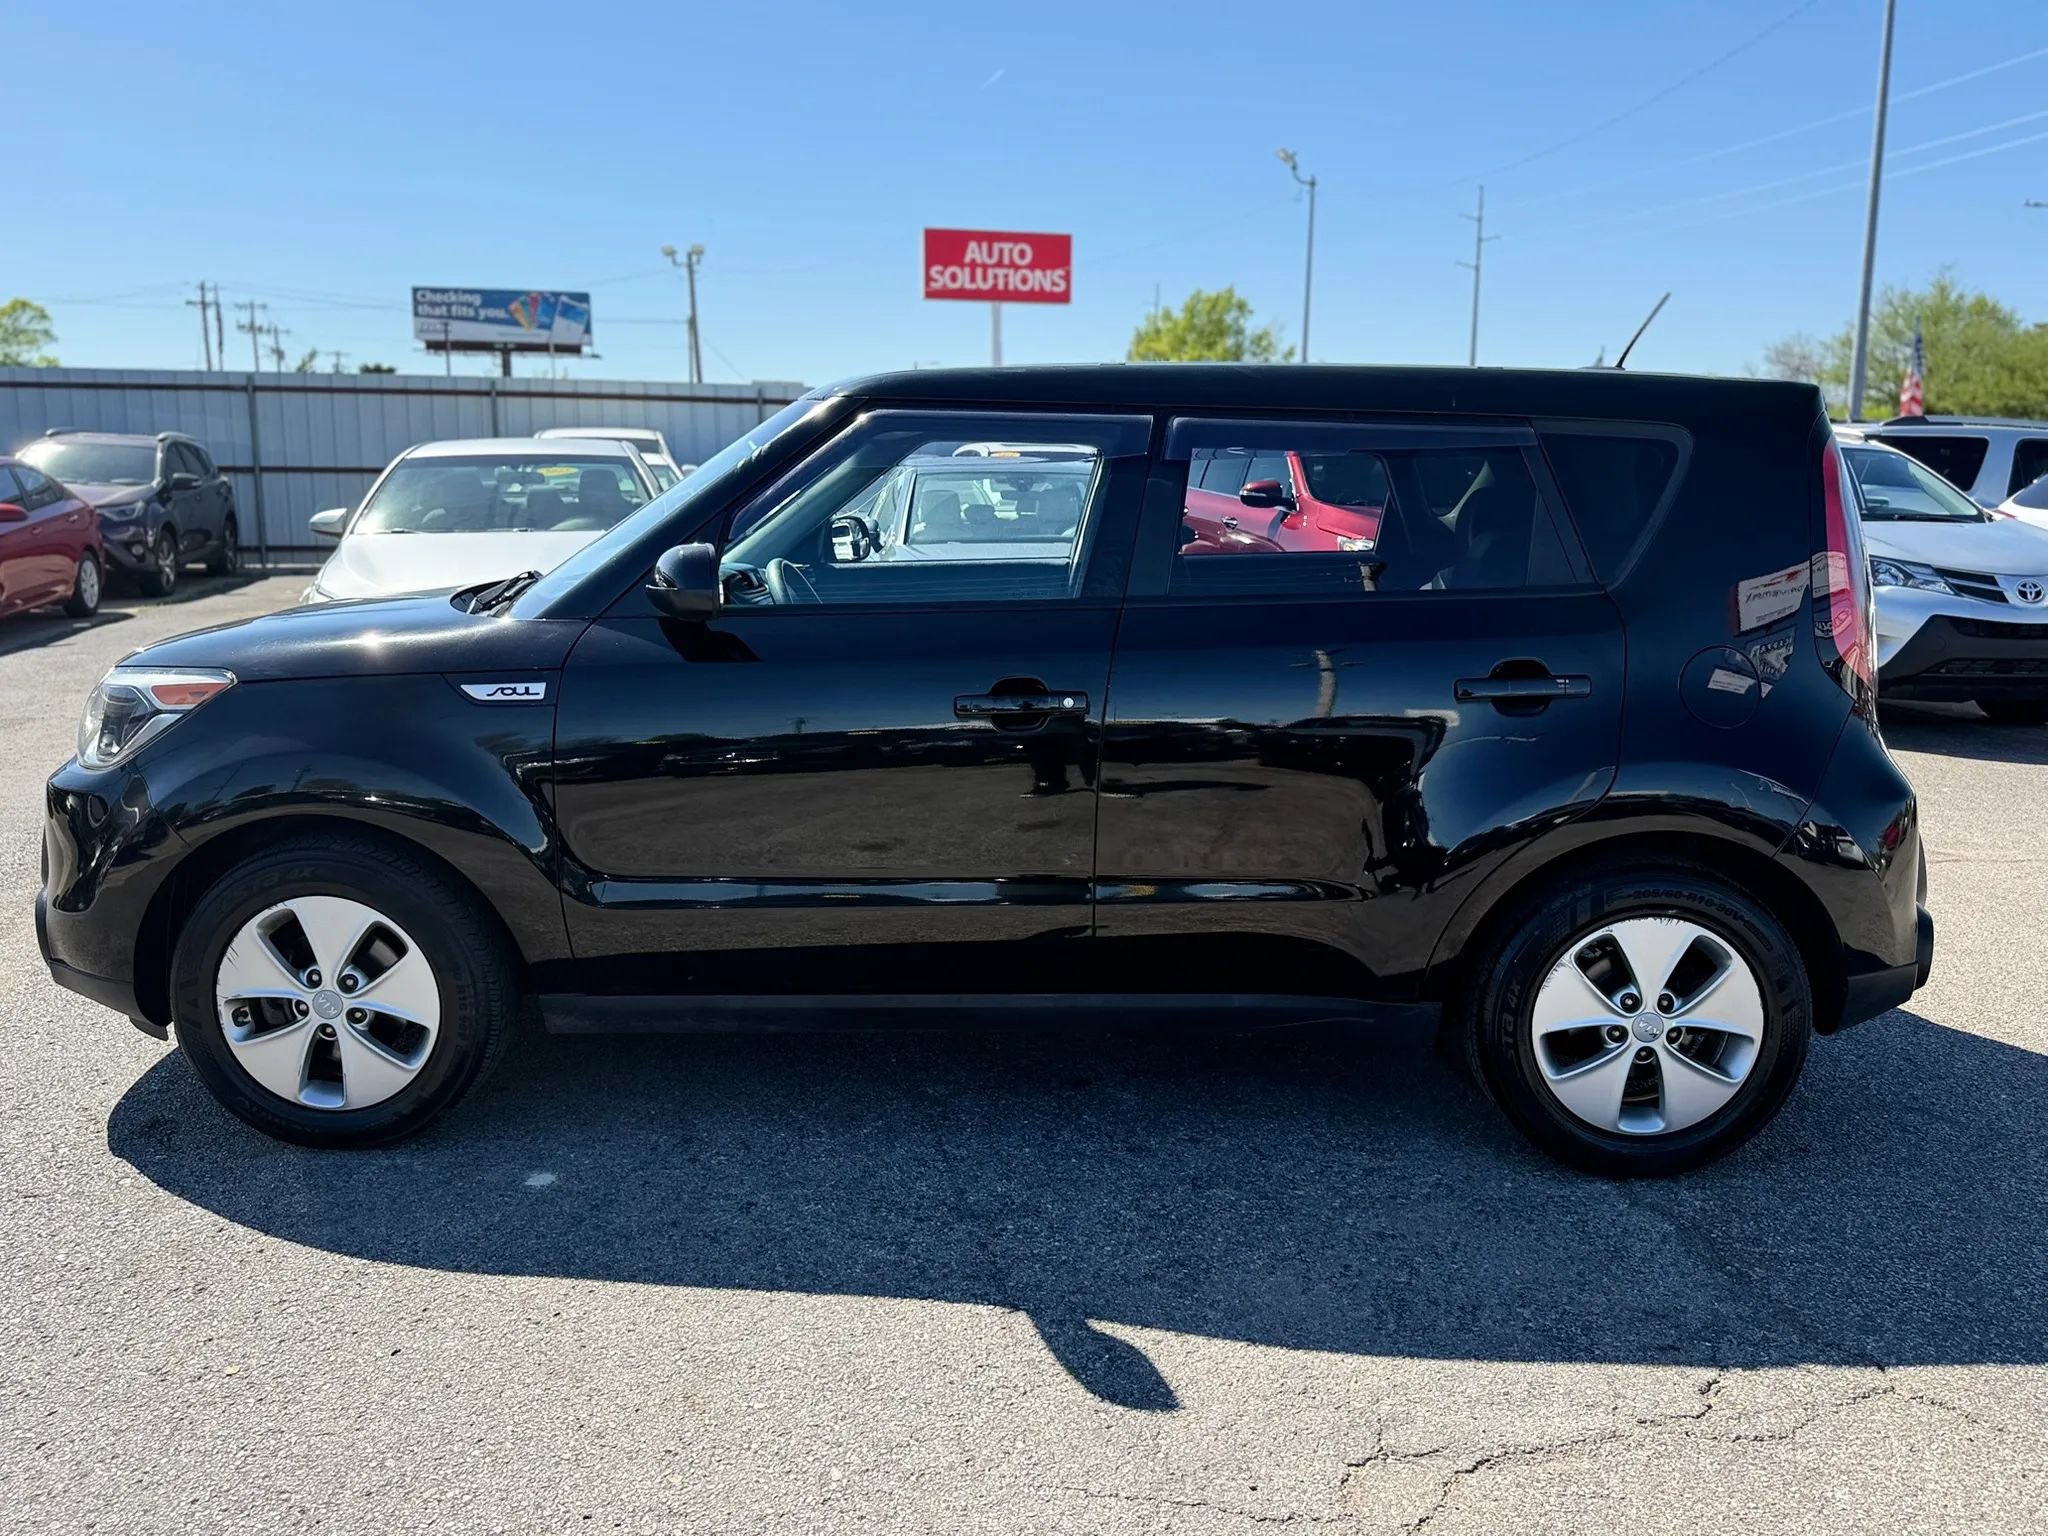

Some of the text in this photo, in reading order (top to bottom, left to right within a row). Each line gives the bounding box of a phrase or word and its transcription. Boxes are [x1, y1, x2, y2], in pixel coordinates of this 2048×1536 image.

[963, 240, 1033, 266] AUTO
[929, 265, 1067, 293] SOLUTIONS
[415, 290, 482, 307] Checking
[417, 303, 511, 321] that fits you.
[317, 993, 338, 1016] KIA
[1638, 1016, 1661, 1037] KIA
